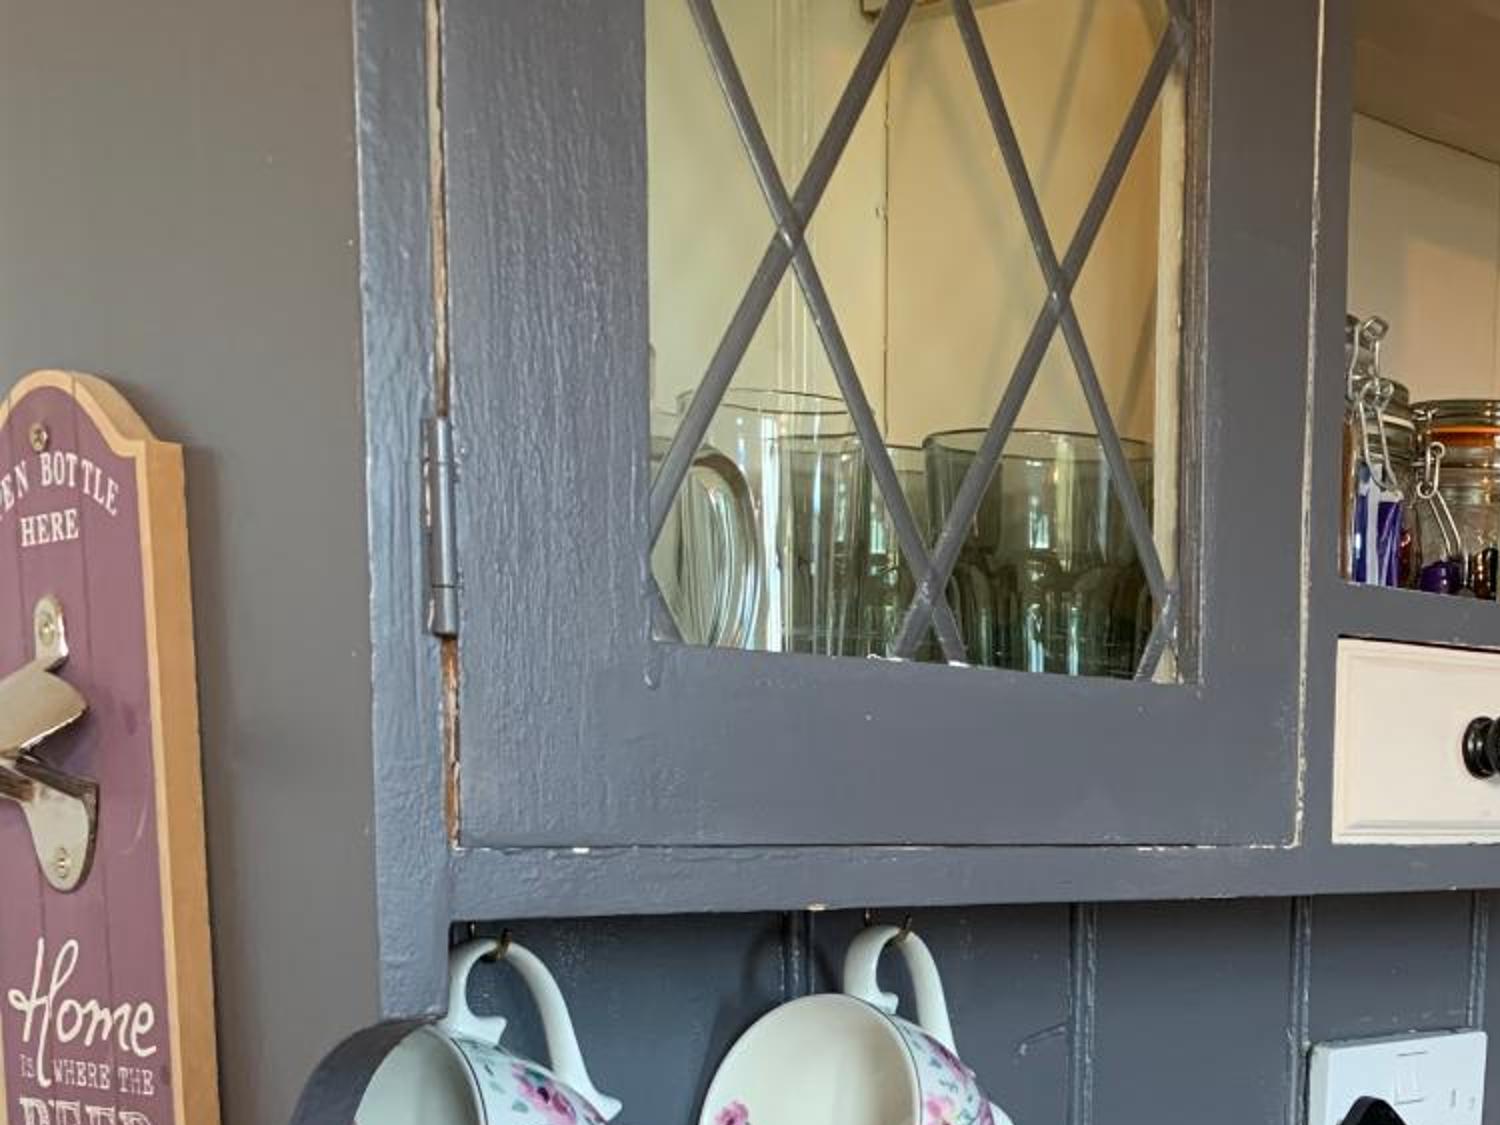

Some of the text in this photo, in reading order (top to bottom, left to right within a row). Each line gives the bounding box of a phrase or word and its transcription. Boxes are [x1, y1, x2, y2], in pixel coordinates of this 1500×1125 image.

[0, 450, 119, 517] EN BOTTLE
[20, 508, 79, 547] HERE
[8, 937, 157, 1087] Home
[53, 1058, 111, 1090] WHERE
[118, 1066, 155, 1096] THE
